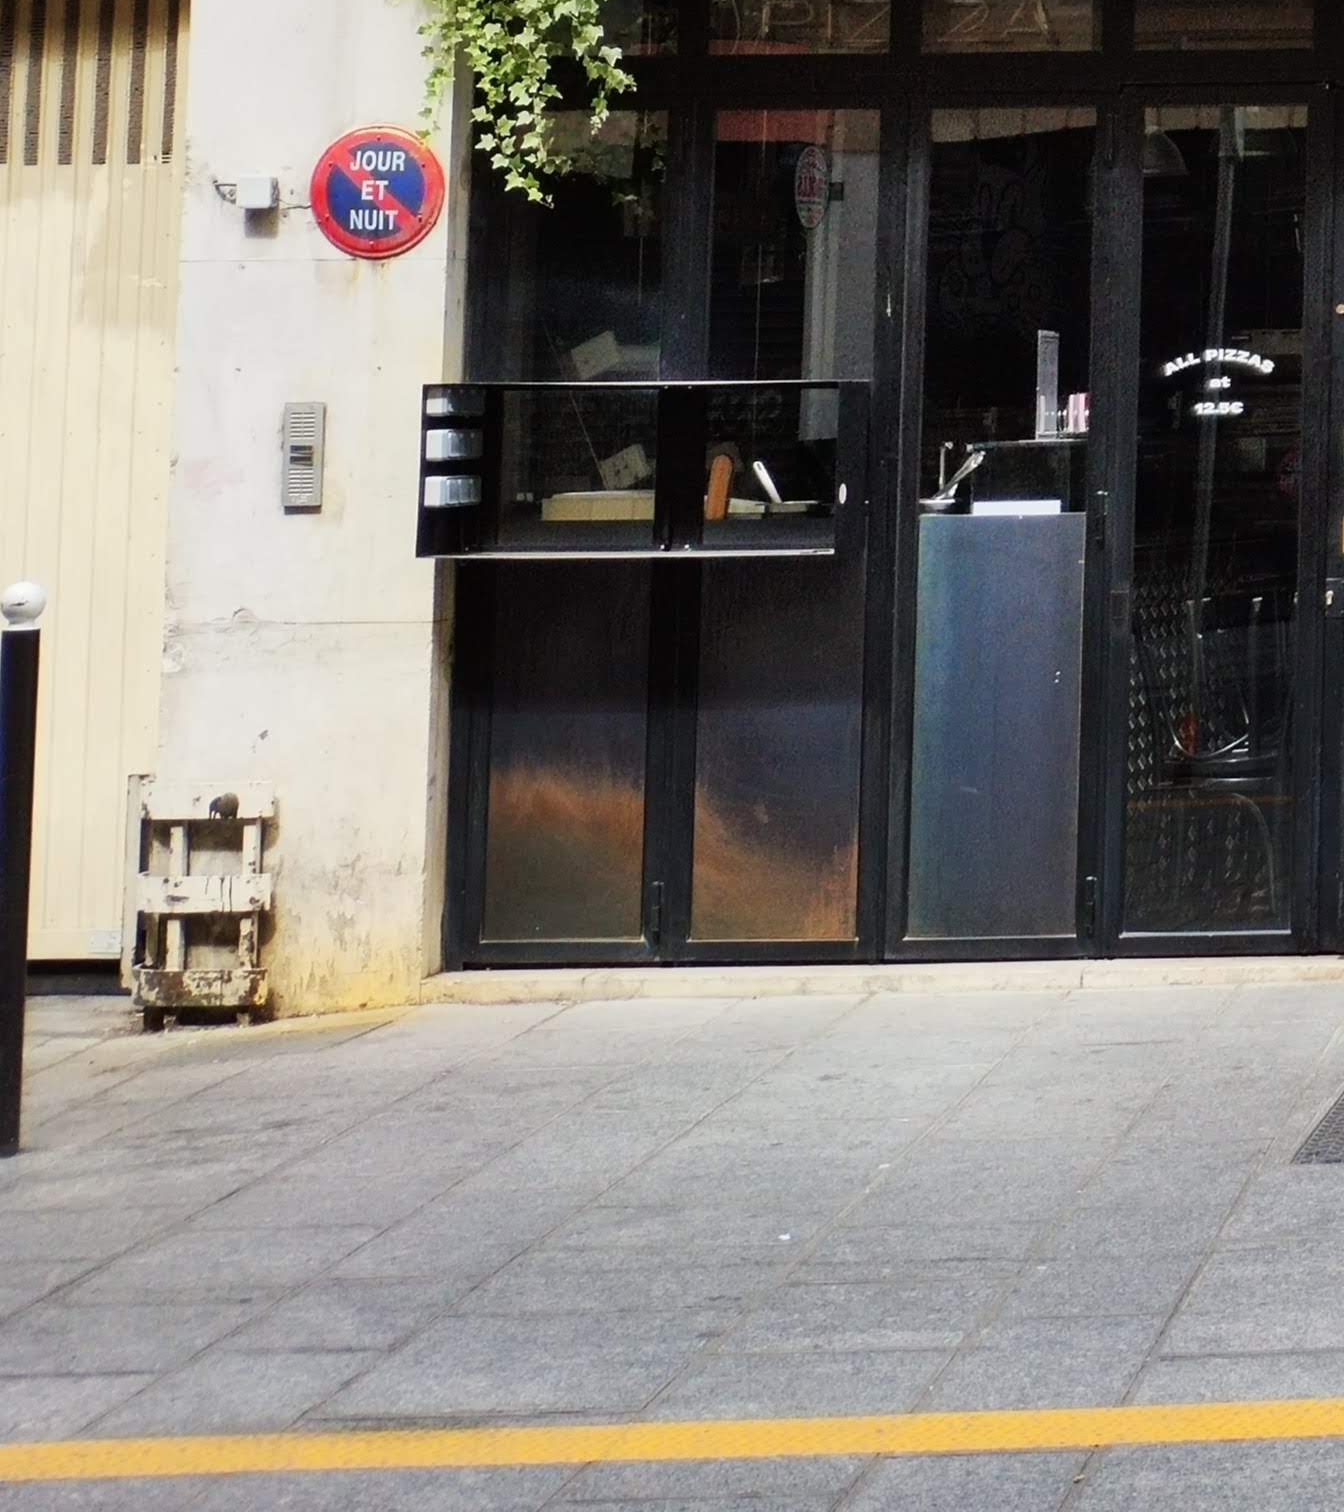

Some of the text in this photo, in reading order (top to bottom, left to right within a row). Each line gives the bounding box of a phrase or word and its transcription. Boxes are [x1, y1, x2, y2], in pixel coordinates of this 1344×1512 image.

[350, 149, 406, 172] JOUR
[361, 179, 389, 201] ET
[350, 209, 399, 231] NUIT
[1163, 348, 1275, 377] ALL PIZZAS
[1208, 375, 1232, 389] at
